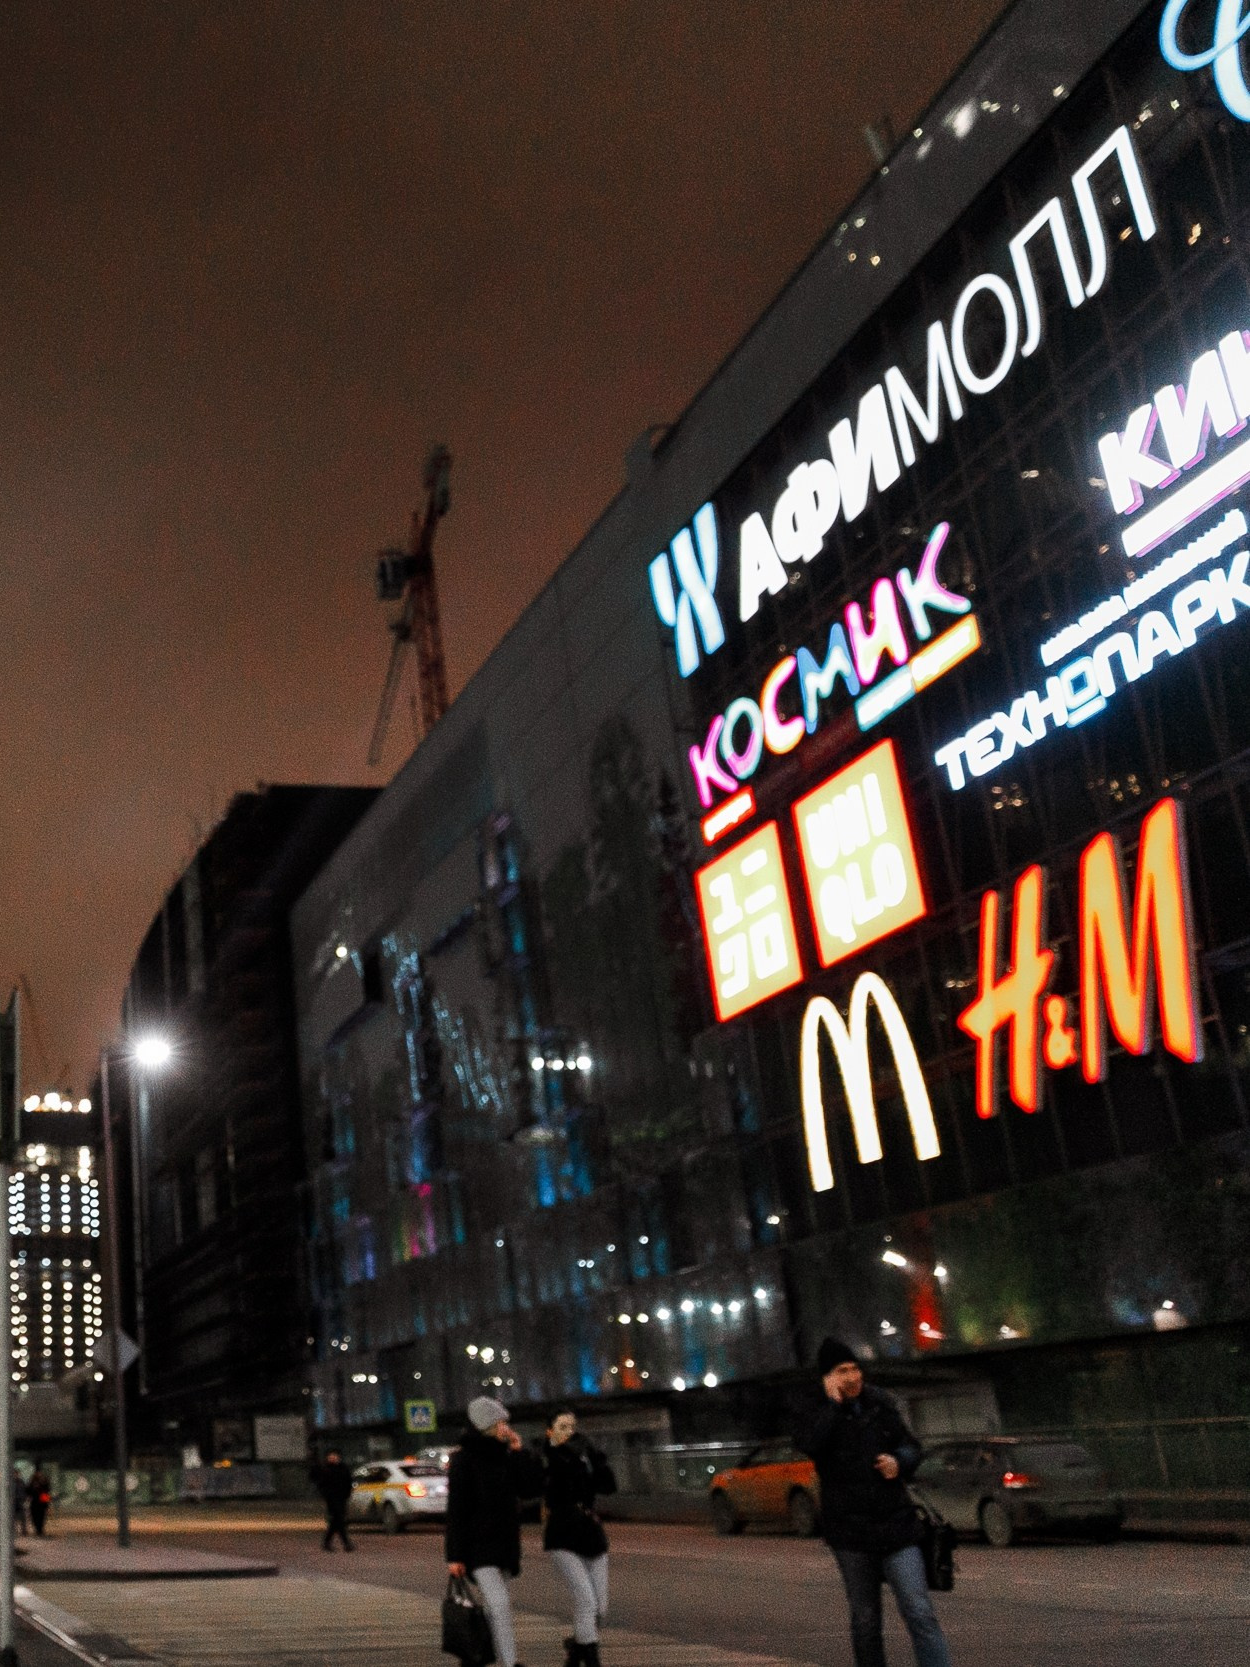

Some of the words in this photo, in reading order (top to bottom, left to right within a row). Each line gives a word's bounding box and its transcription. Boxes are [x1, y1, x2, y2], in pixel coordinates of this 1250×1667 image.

[739, 125, 1156, 622] АФИМОЛЛ
[689, 521, 972, 808] КОСМИК
[934, 550, 1250, 790] ТЕХНОПАРК
[804, 772, 888, 869] UNI
[819, 842, 908, 943] QLO
[956, 797, 1200, 1119] H&M
